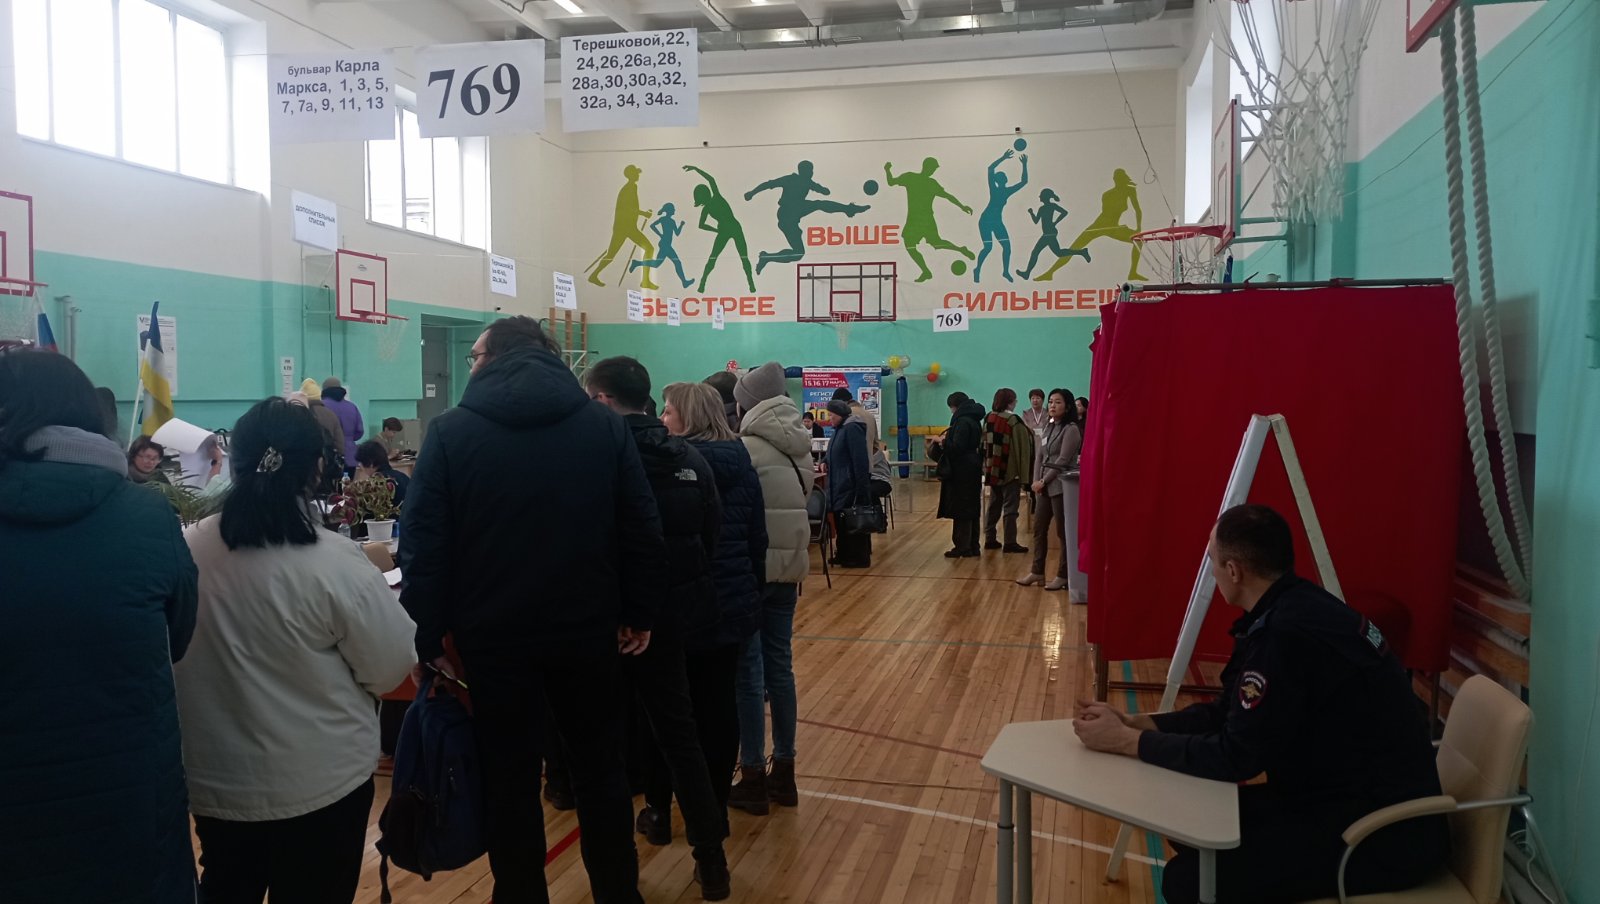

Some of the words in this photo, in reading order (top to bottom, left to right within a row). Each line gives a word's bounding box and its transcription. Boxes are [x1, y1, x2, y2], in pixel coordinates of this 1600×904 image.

[287, 65, 332, 77] бульвар
[335, 60, 380, 75] Карла
[277, 81, 332, 96] Маркса,
[340, 78, 353, 93] 1,
[357, 77, 371, 93] 3,
[375, 77, 389, 93] 5,
[427, 62, 521, 119] 769
[282, 100, 294, 115] 7,
[298, 99, 318, 113] 7а,
[321, 98, 335, 112] 9,
[340, 97, 361, 112] 11,
[366, 96, 384, 110] 13
[580, 95, 612, 110] 32а,
[616, 92, 640, 108] 34,
[645, 91, 679, 106] 34а.
[308, 216, 326, 228] СПИСОК
[806, 224, 900, 247] ВЫШЕ
[943, 289, 1119, 312] СИЛЬНЕЕ!!
[936, 312, 962, 328] 769
